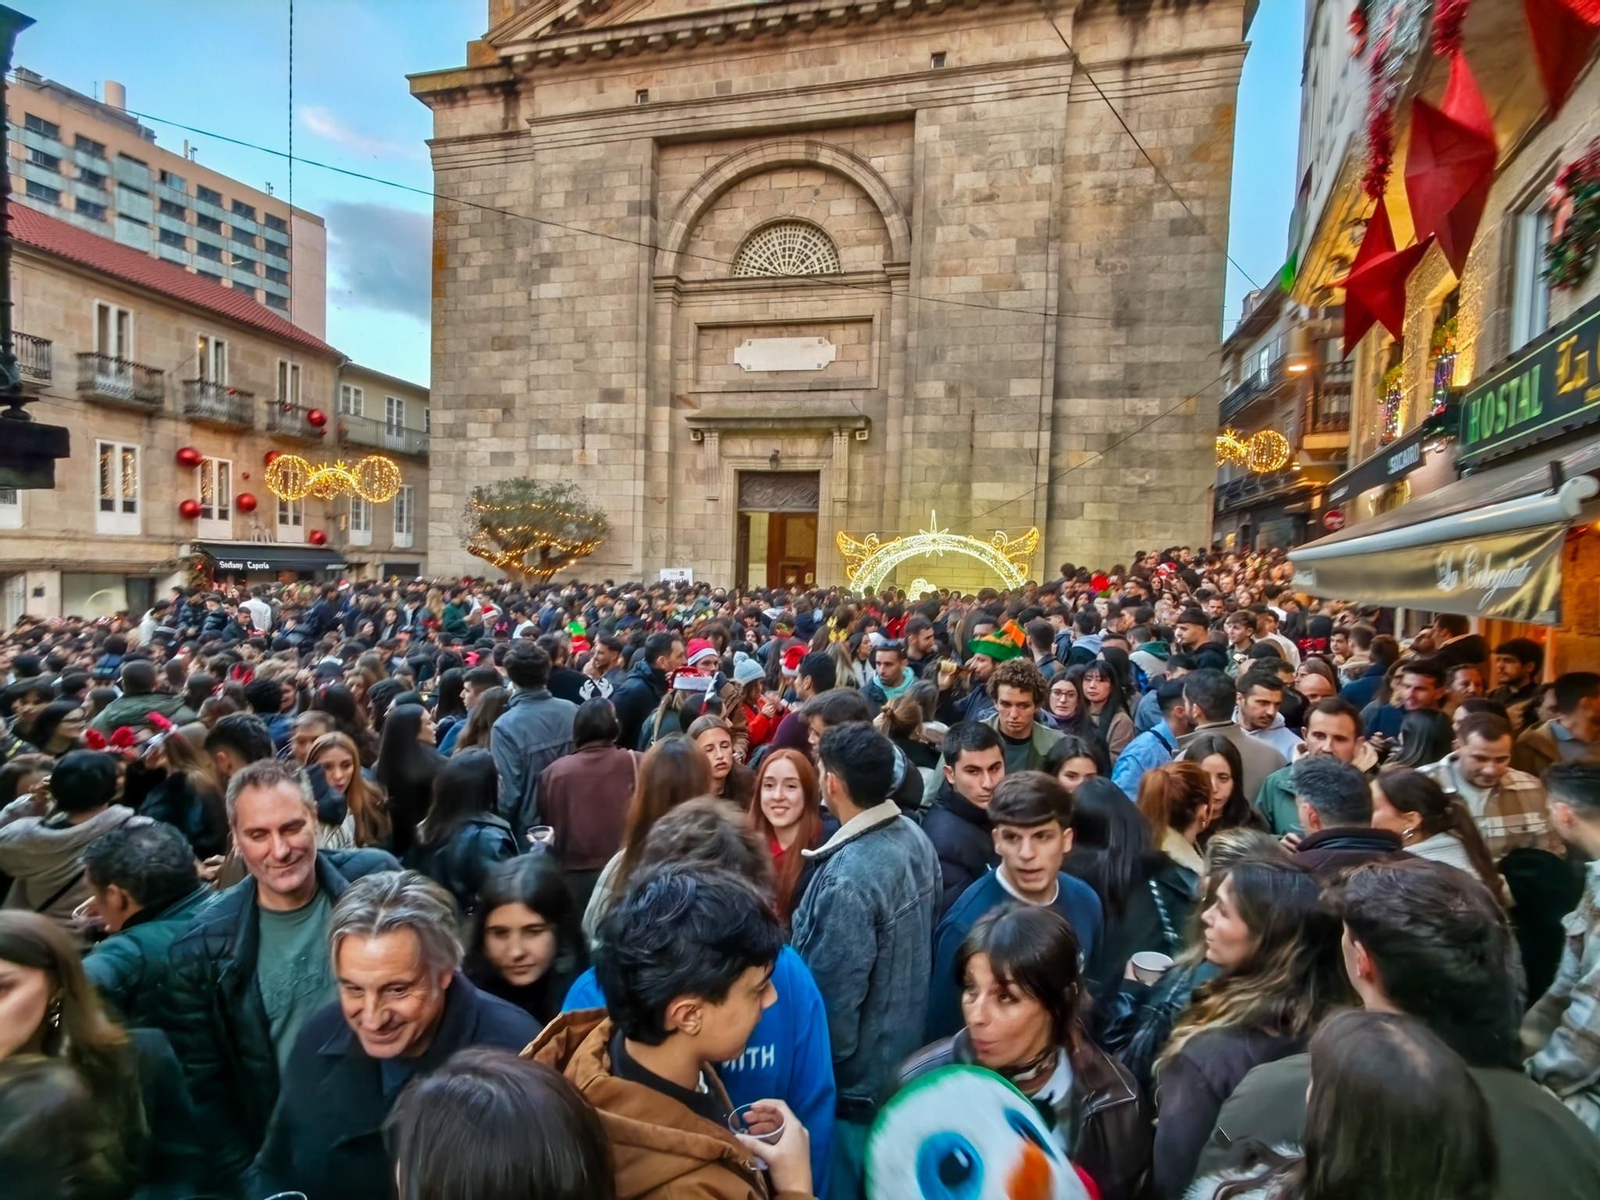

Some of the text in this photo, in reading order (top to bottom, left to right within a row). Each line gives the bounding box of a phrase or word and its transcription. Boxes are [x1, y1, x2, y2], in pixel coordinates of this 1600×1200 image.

[1467, 363, 1544, 445] HOSTAL
[1387, 442, 1420, 476] SOCAIRO
[1436, 550, 1459, 592] La
